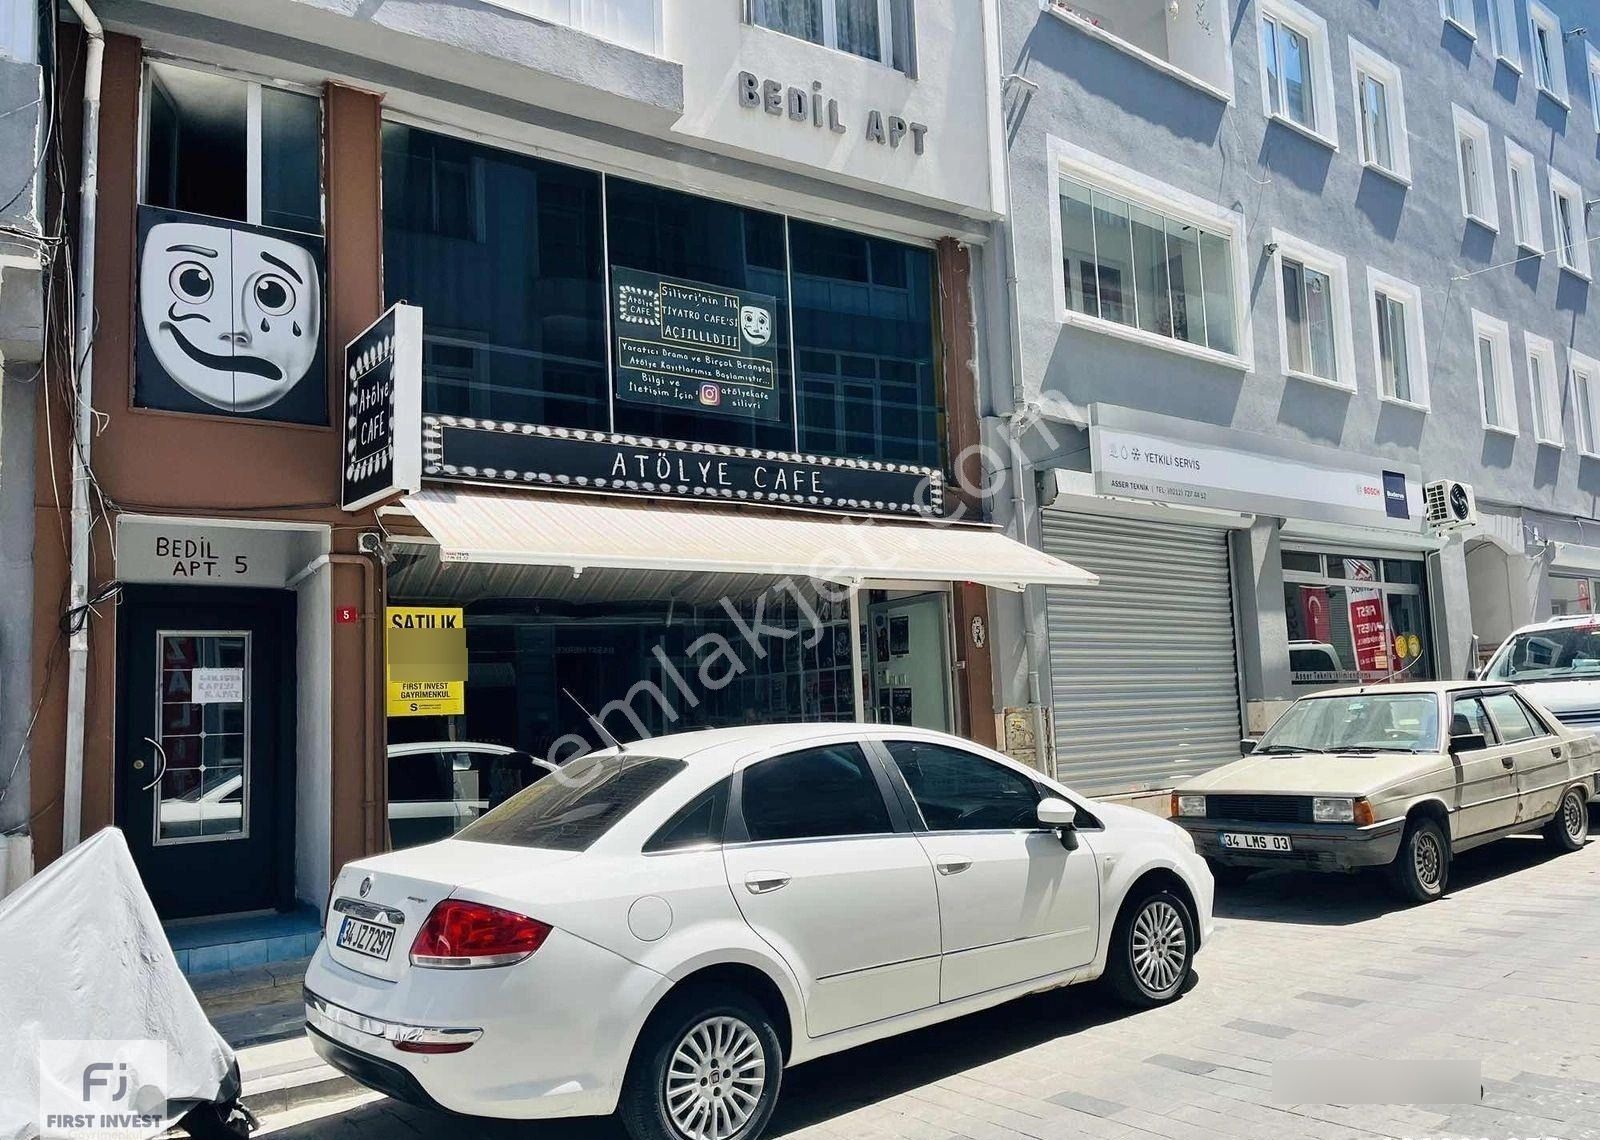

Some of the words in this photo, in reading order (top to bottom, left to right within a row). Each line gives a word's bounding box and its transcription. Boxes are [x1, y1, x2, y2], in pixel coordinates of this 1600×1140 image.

[738, 70, 847, 134] BEDİL
[865, 110, 928, 155] APT
[661, 286, 719, 306] Silivri'nin
[630, 306, 651, 316] CAFE
[661, 305, 700, 320] TİYATRO
[622, 342, 659, 356] Yaratıcı
[662, 349, 688, 361] Drama
[705, 355, 733, 368] Birçok
[629, 356, 657, 369] Atölye
[660, 360, 712, 377] Kayıtlarımız
[641, 372, 665, 387] Bilgi
[670, 379, 681, 387] ve
[628, 381, 669, 396] İletişim
[721, 388, 769, 400] atölyekafe
[358, 381, 389, 414] Atölye
[732, 399, 761, 409] silivri
[361, 410, 385, 445] CAFE
[1144, 452, 1173, 466] YETKİLİ
[1174, 456, 1201, 471] SERVİS
[611, 452, 732, 486] ATÖLYE
[754, 466, 825, 494] CAFE
[1111, 480, 1129, 489] ASSER
[1130, 481, 1150, 492] TEKNİK
[156, 536, 219, 559] BEDİL
[172, 561, 221, 577] APT.
[234, 556, 248, 574] 5
[343, 610, 350, 620] 5
[402, 682, 422, 690] FIRST
[424, 682, 449, 690] INVEST
[1224, 834, 1240, 847] 34
[1244, 835, 1267, 848] LMS
[1273, 837, 1289, 850] 03
